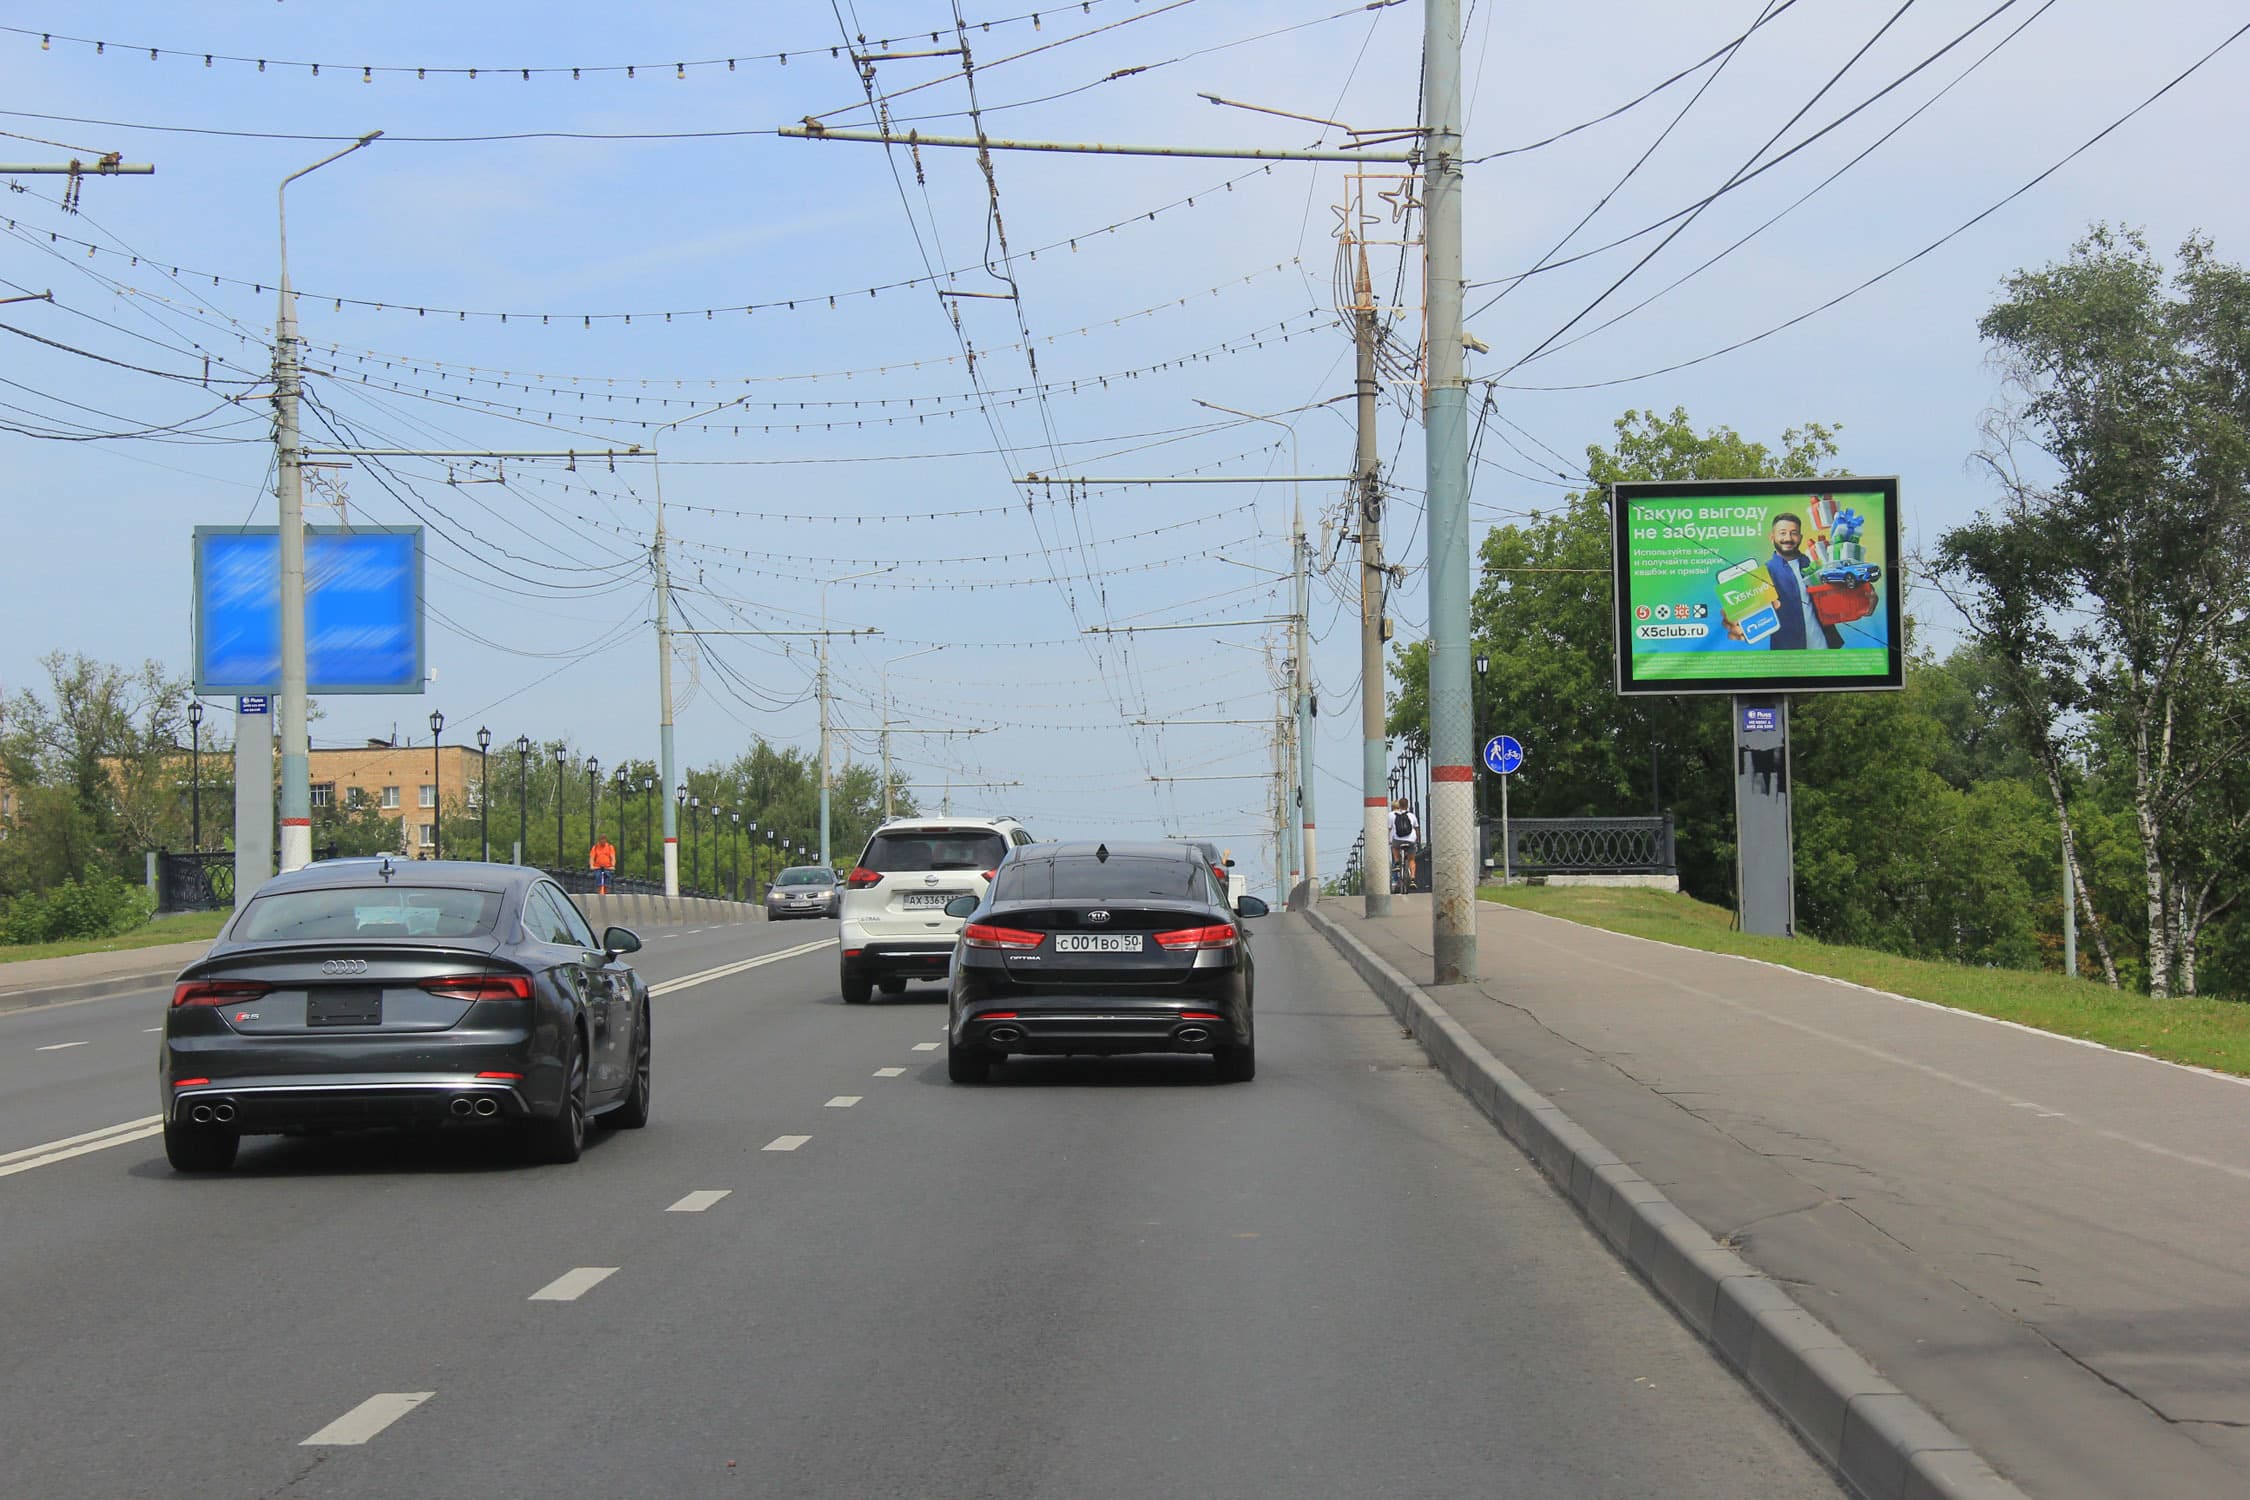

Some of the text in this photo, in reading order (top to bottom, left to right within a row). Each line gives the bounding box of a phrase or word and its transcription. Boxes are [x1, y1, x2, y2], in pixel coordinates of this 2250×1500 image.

[1633, 506, 1768, 523] Такую выгоду
[1633, 523, 1762, 541] не забудешь!
[1633, 547, 1720, 557] Используйте карту
[1641, 558, 1689, 567] получайте
[1677, 567, 1709, 577] призы!
[1641, 625, 1705, 638] X5club.ru
[1091, 912, 1107, 921] KIA
